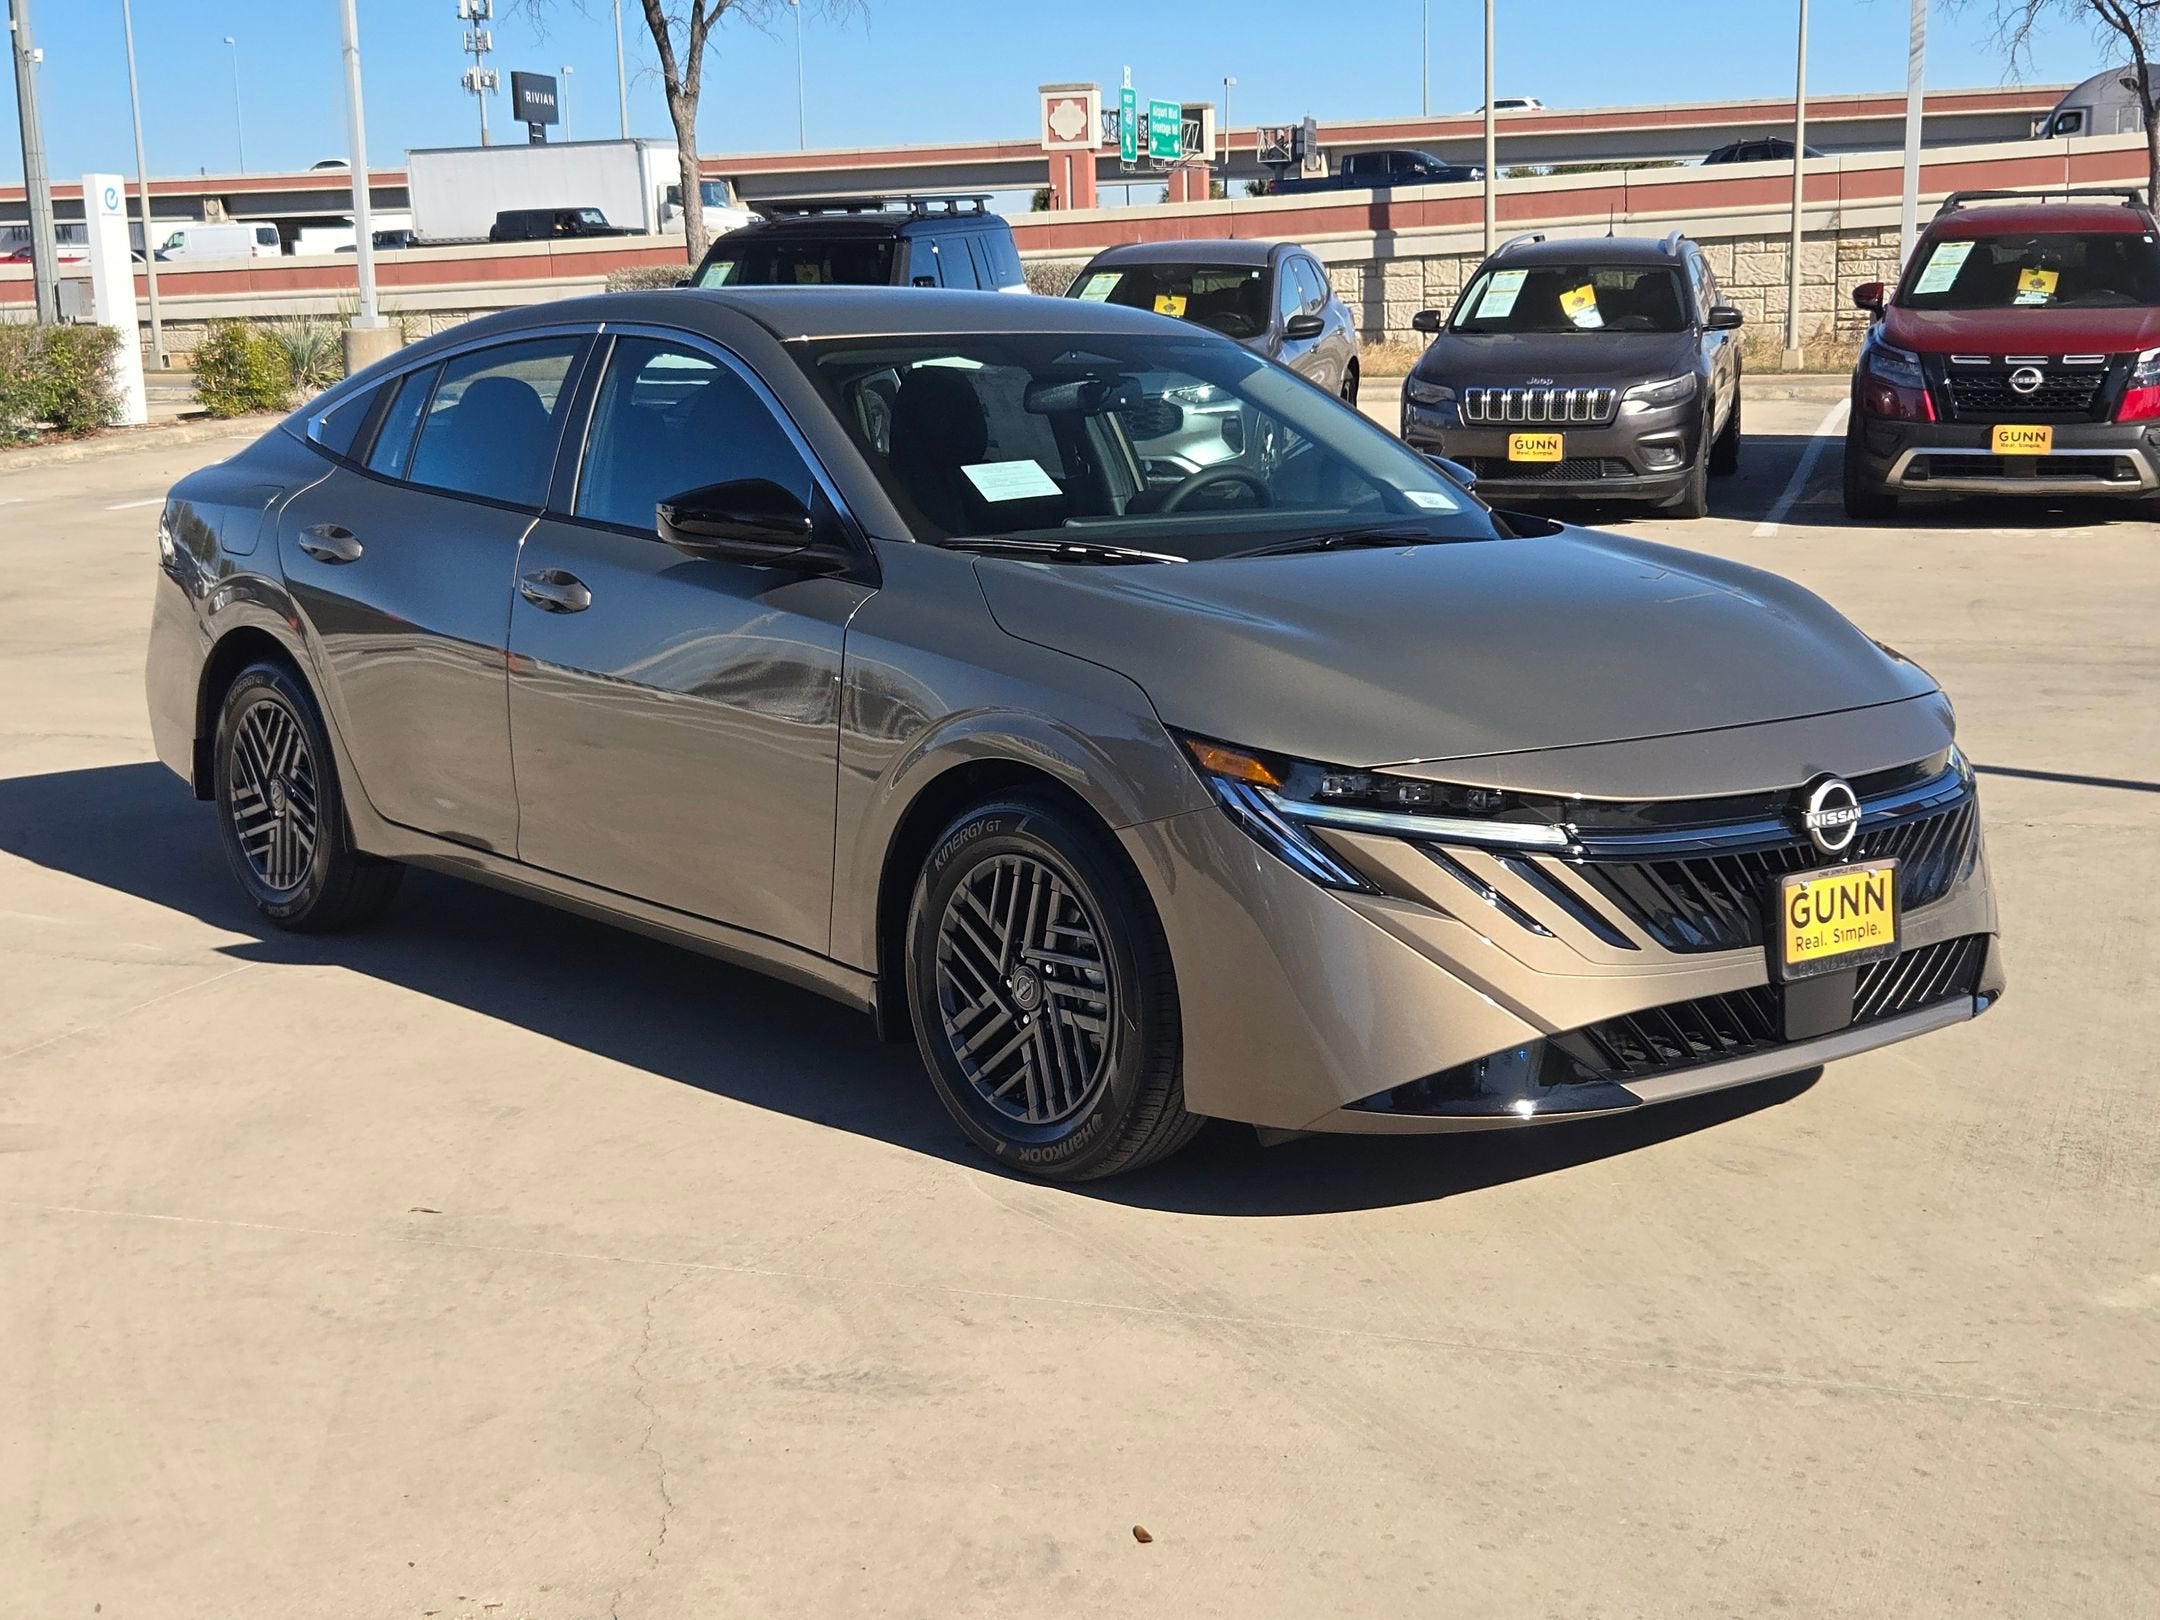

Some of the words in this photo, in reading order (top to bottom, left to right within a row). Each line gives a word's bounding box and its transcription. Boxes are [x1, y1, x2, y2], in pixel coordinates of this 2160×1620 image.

[525, 90, 555, 106] RIVIAN
[1526, 377, 1553, 386] Jeep
[1999, 431, 2046, 442] GUNN
[1514, 440, 1557, 450] GUNN
[1807, 807, 1862, 829] NISSAN
[986, 820, 1002, 832] GT
[1790, 878, 1885, 929] GUNN
[1795, 931, 1827, 952] Real.
[1833, 920, 1881, 944] Simple.
